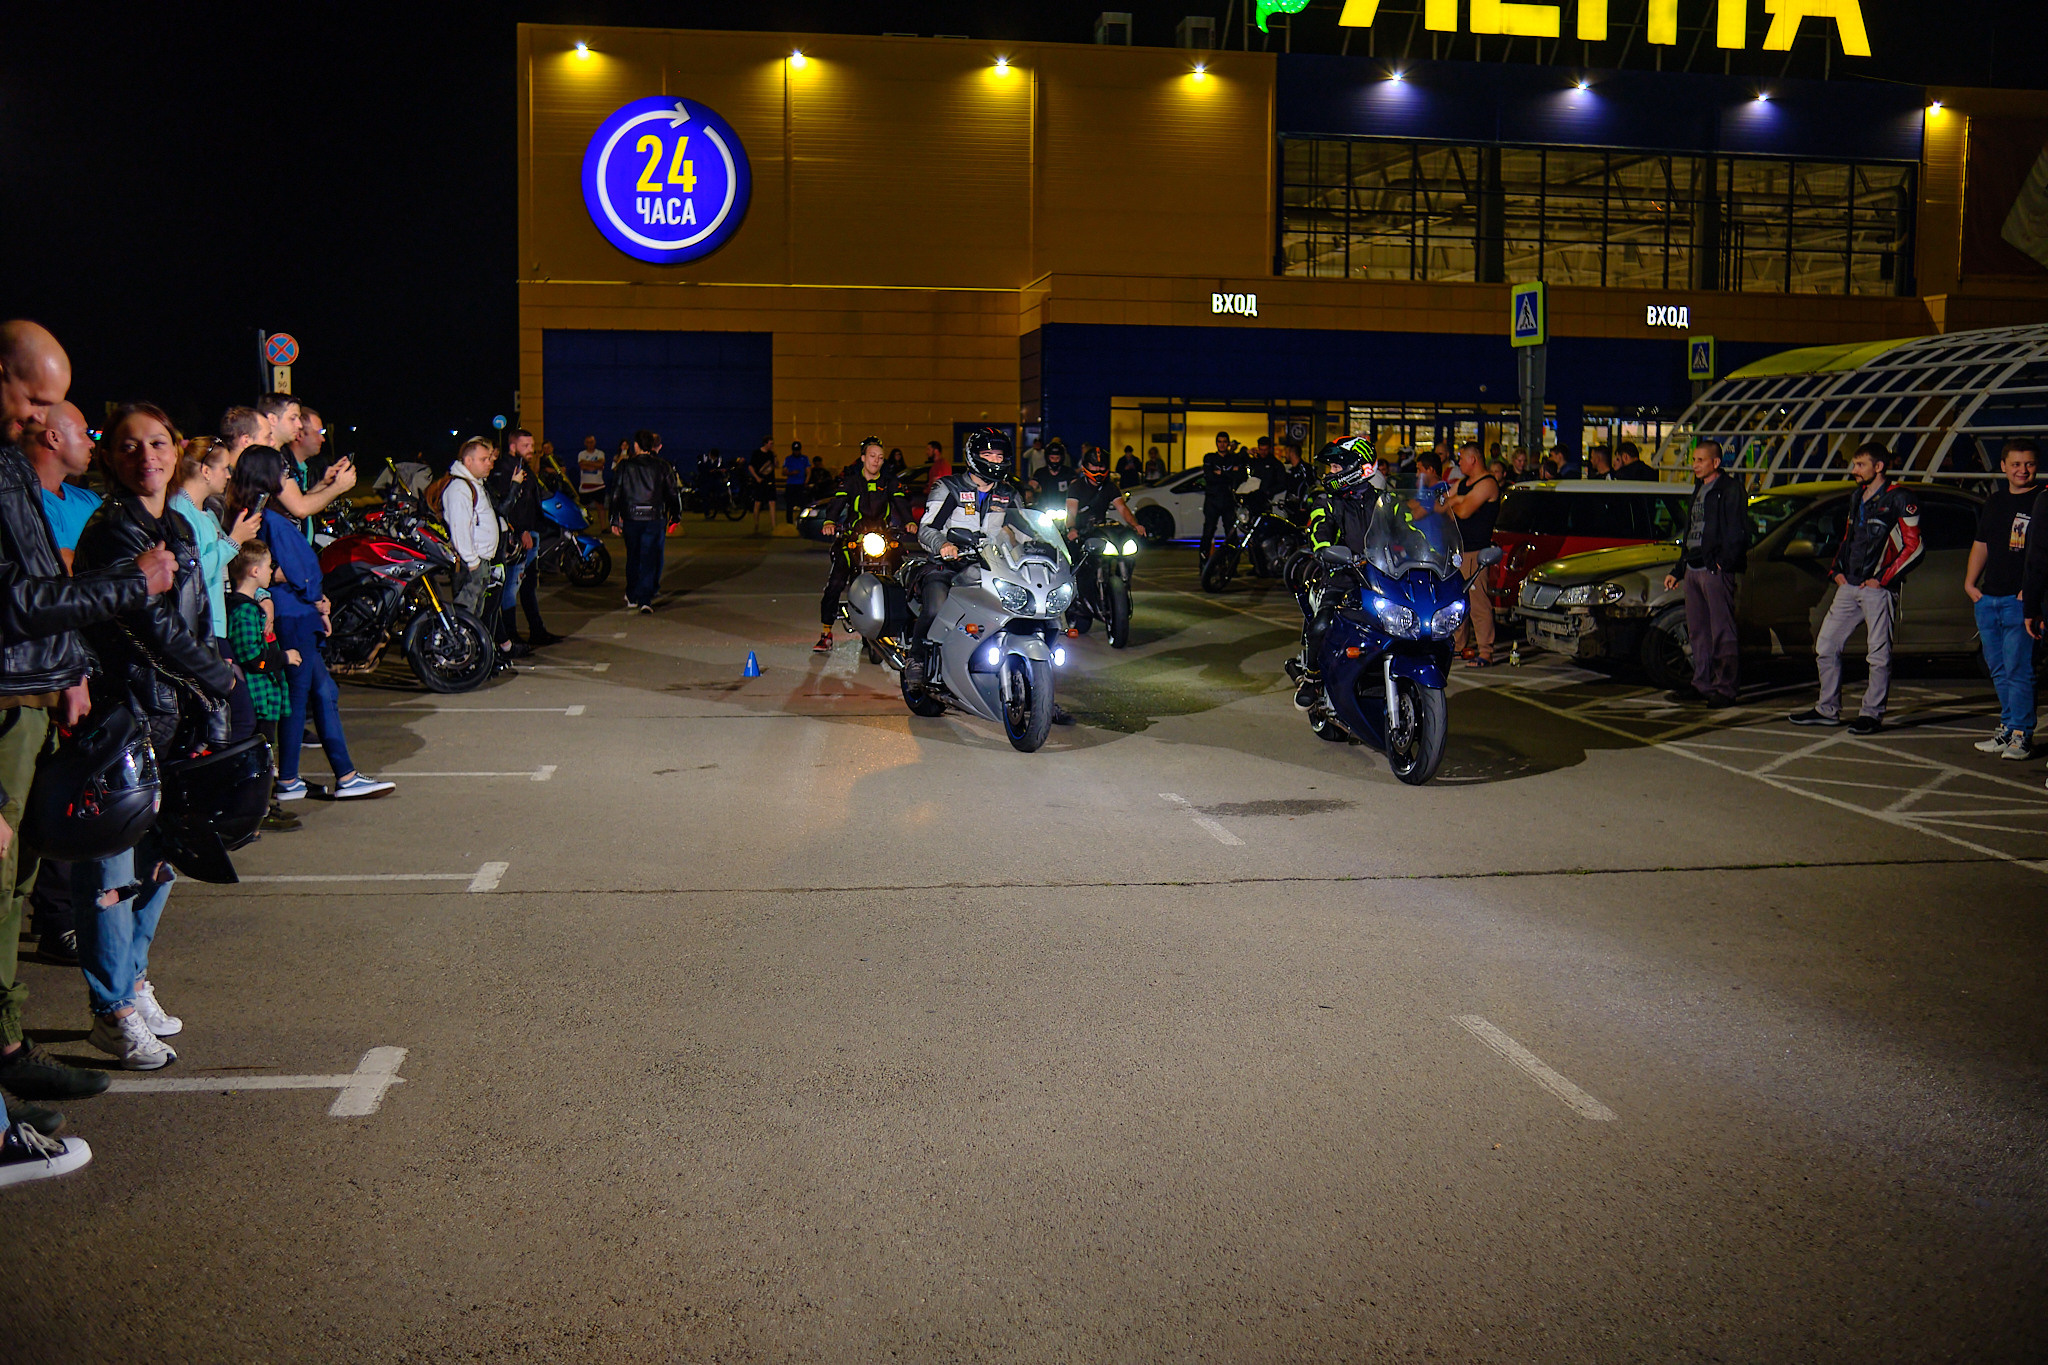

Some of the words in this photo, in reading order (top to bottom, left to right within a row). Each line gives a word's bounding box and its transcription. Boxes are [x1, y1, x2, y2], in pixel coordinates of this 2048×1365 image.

[636, 134, 697, 193] 24
[636, 197, 696, 226] ЧАСА
[1211, 292, 1259, 318] ВХОД
[1646, 304, 1691, 329] ВХОД
